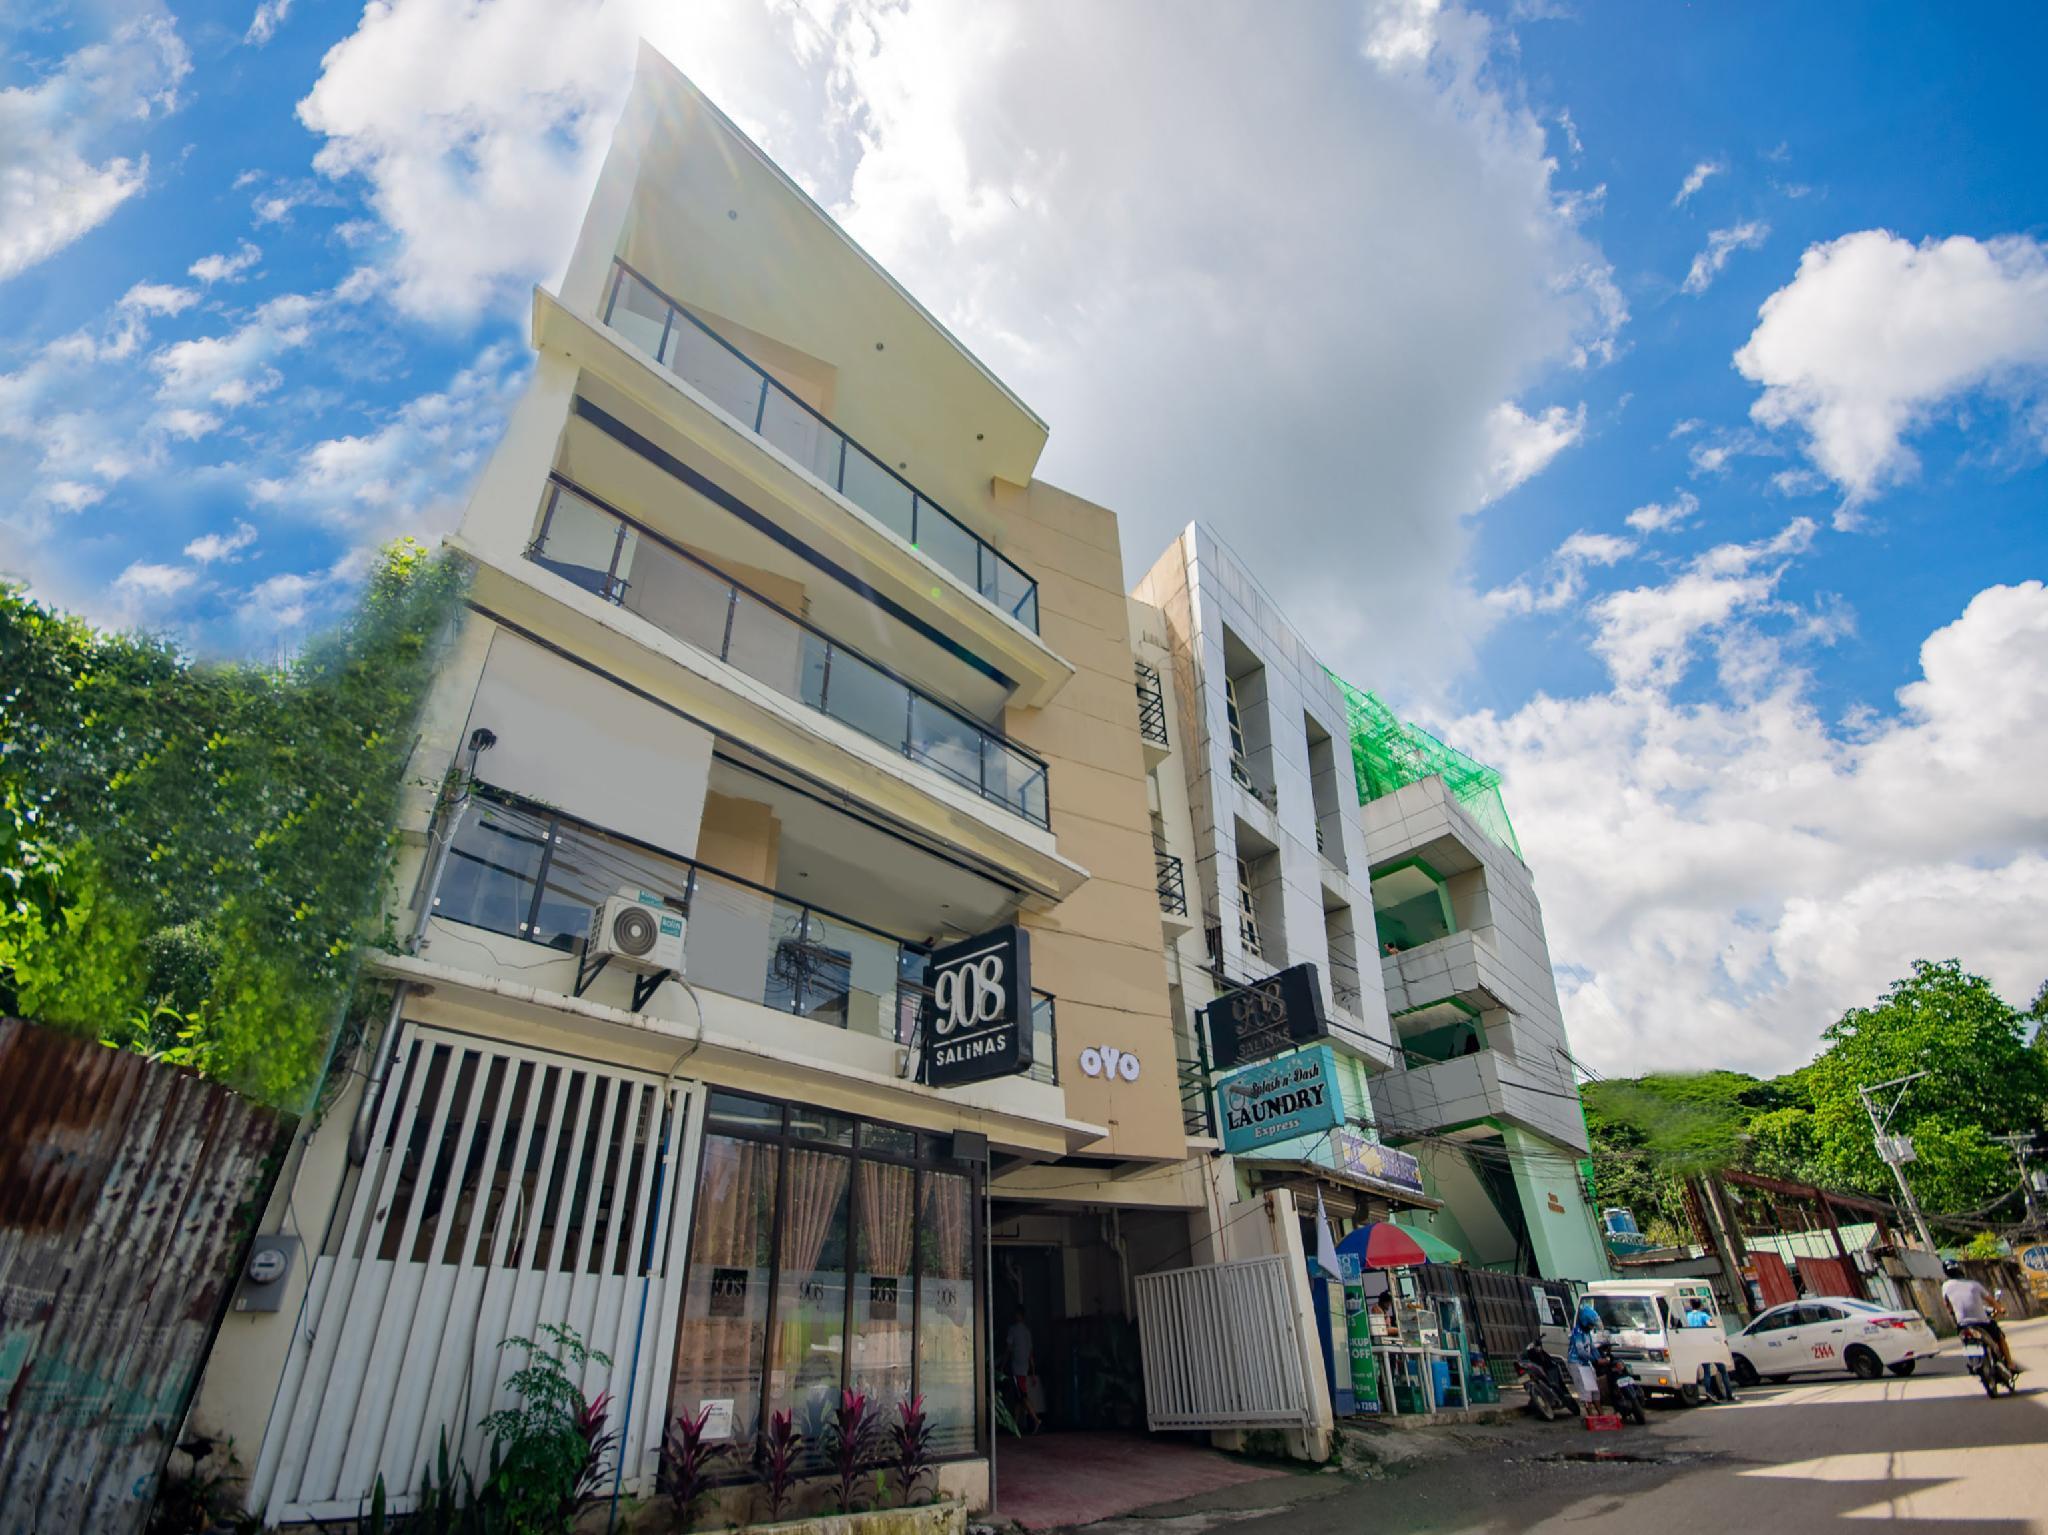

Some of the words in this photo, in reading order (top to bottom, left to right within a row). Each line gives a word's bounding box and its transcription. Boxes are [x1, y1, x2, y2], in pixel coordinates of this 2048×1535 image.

[934, 955, 1006, 1035] 908
[1080, 1044, 1141, 1083] OYO
[1293, 1063, 1320, 1083] Dash
[1226, 1083, 1325, 1131] LAUNDRY
[1255, 1118, 1300, 1139] Express
[714, 1276, 745, 1298] 908
